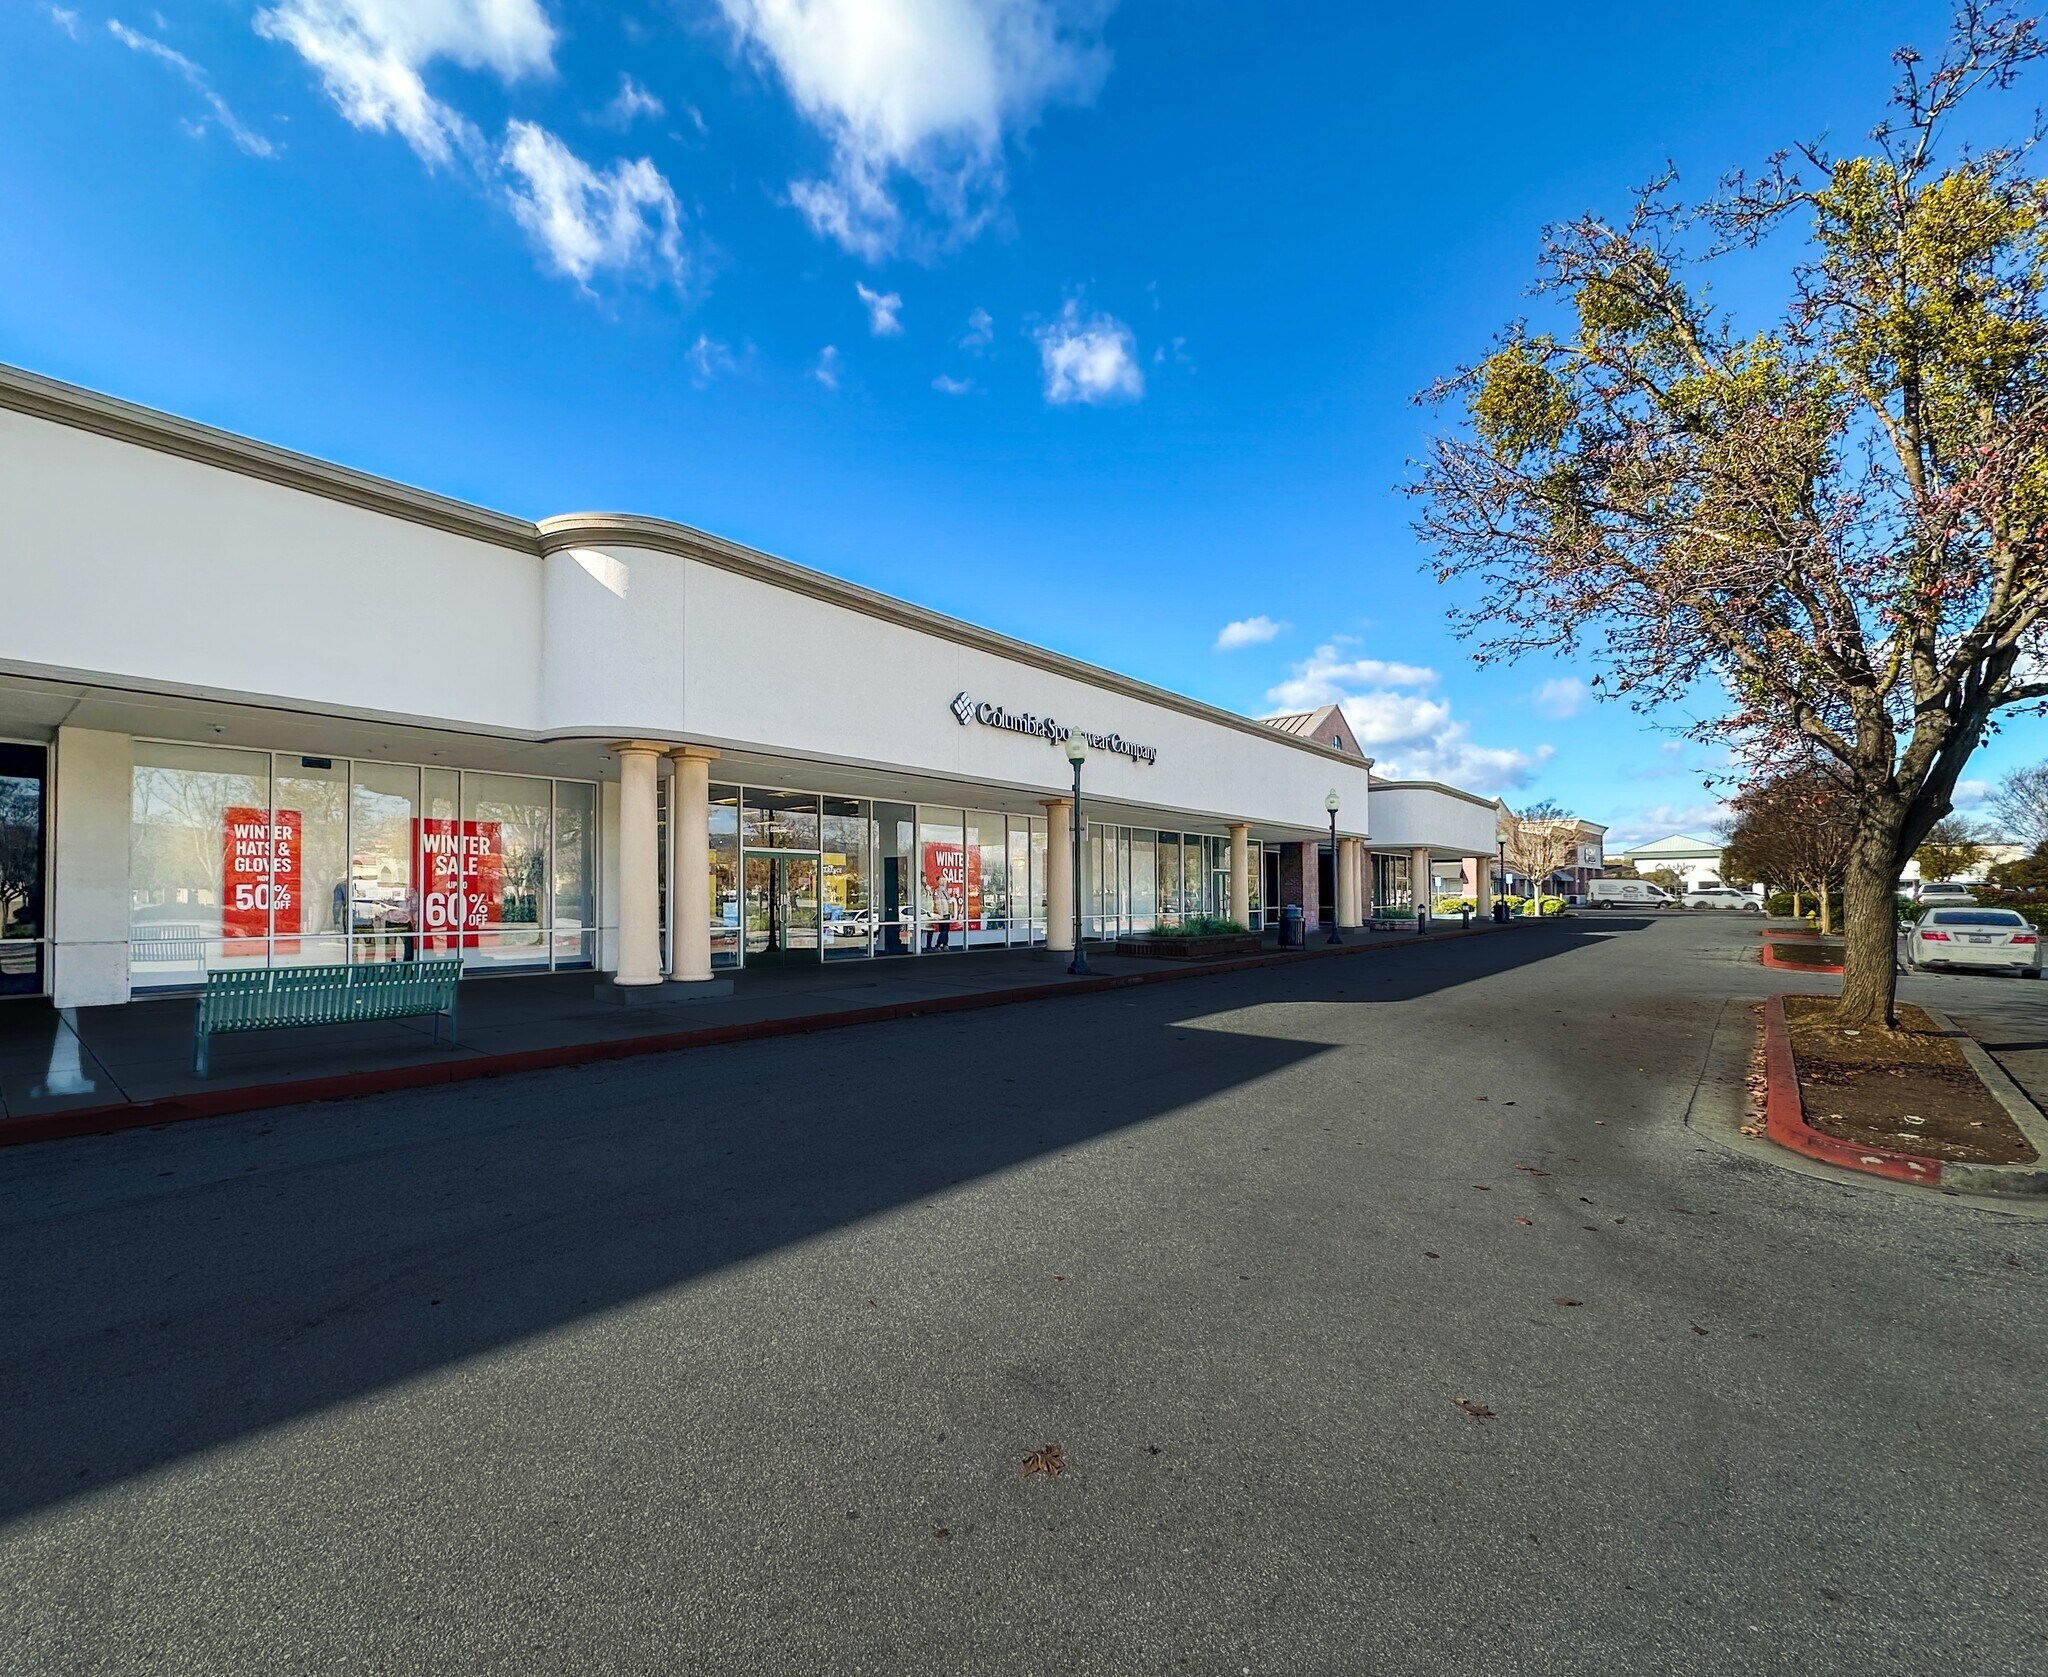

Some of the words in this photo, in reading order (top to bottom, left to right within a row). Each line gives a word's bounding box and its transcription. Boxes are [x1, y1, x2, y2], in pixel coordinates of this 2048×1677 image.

[976, 702, 1046, 738] Columbia
[1044, 717, 1112, 752] Spowear
[1109, 733, 1157, 765] Company
[234, 824, 292, 840] WINTER
[236, 841, 274, 856] HATS
[278, 842, 290, 856] &
[423, 834, 491, 855] WINTER
[234, 857, 292, 873] GLOVES
[935, 850, 970, 867] WINTE
[942, 867, 965, 883] SALE
[1666, 862, 1696, 872] Ashley
[235, 883, 291, 910] 50%
[274, 900, 291, 910] OFF
[425, 892, 488, 927] 60%
[468, 914, 488, 926] OFF
